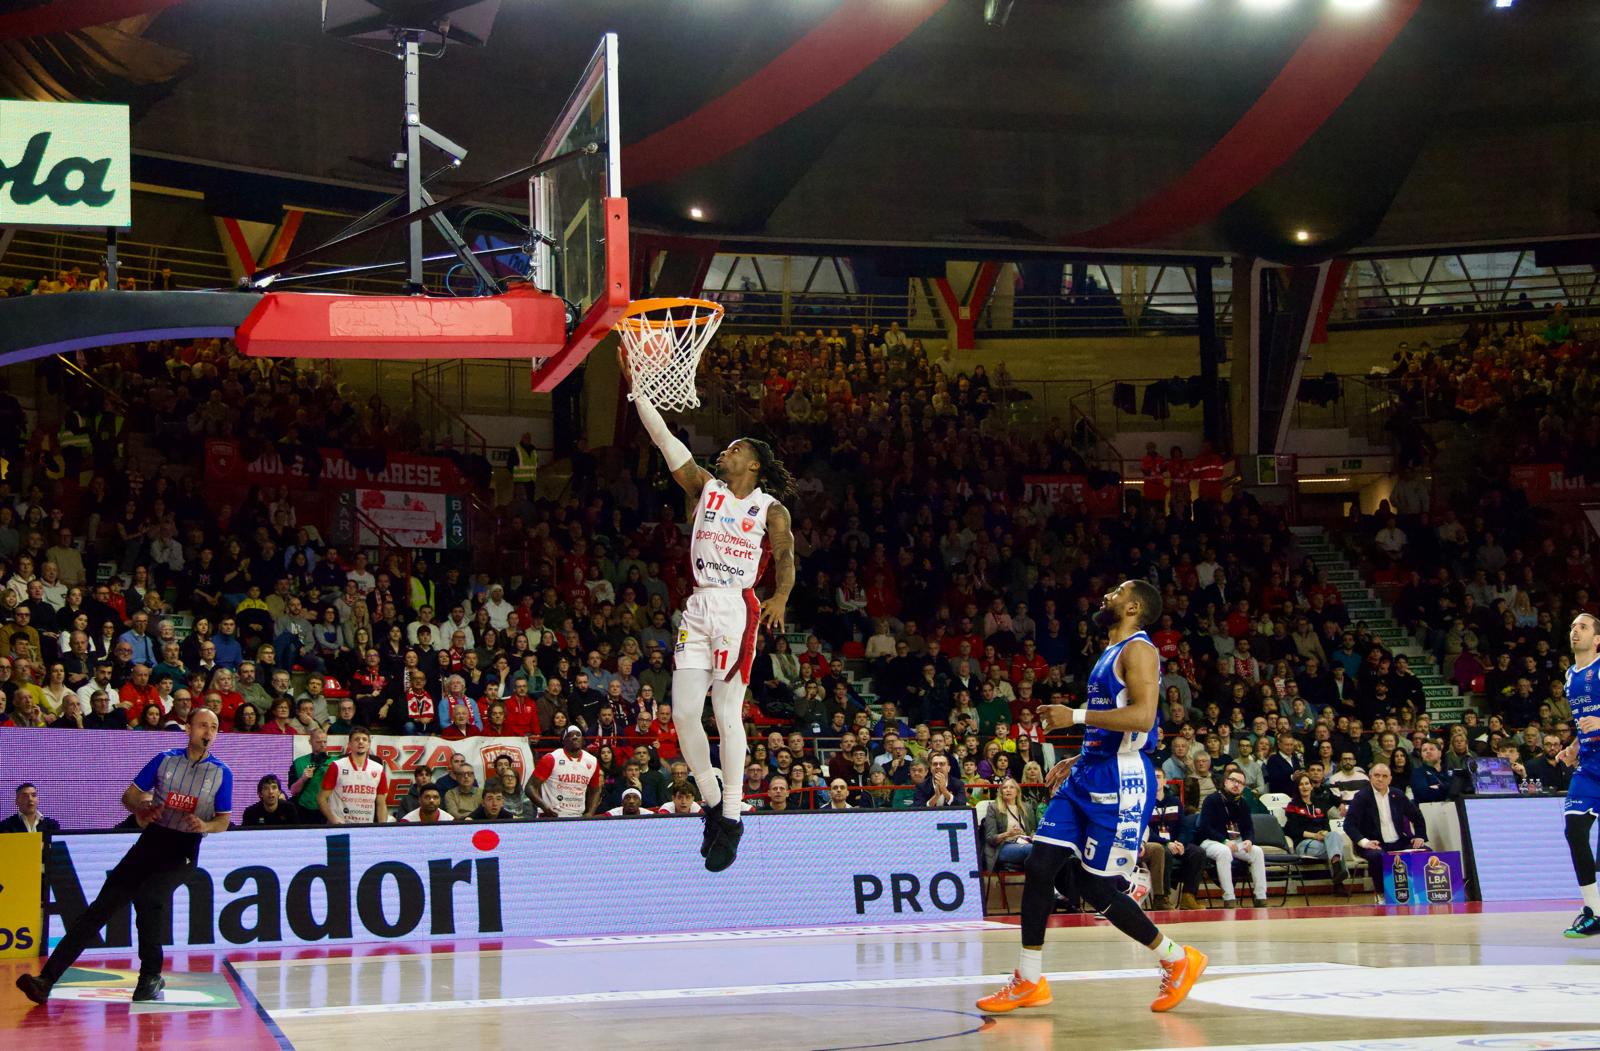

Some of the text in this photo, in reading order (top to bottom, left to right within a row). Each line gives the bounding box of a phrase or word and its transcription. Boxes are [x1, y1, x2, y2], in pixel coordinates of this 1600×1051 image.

[0, 131, 116, 207] la
[706, 491, 726, 511] 11
[451, 499, 463, 537] BAR
[706, 561, 744, 577] motorola
[714, 649, 728, 670] 11
[325, 744, 456, 772] RZA
[342, 784, 376, 794] VARESE
[937, 823, 968, 863] T
[1084, 836, 1098, 860] 5
[1428, 875, 1448, 884] LBA
